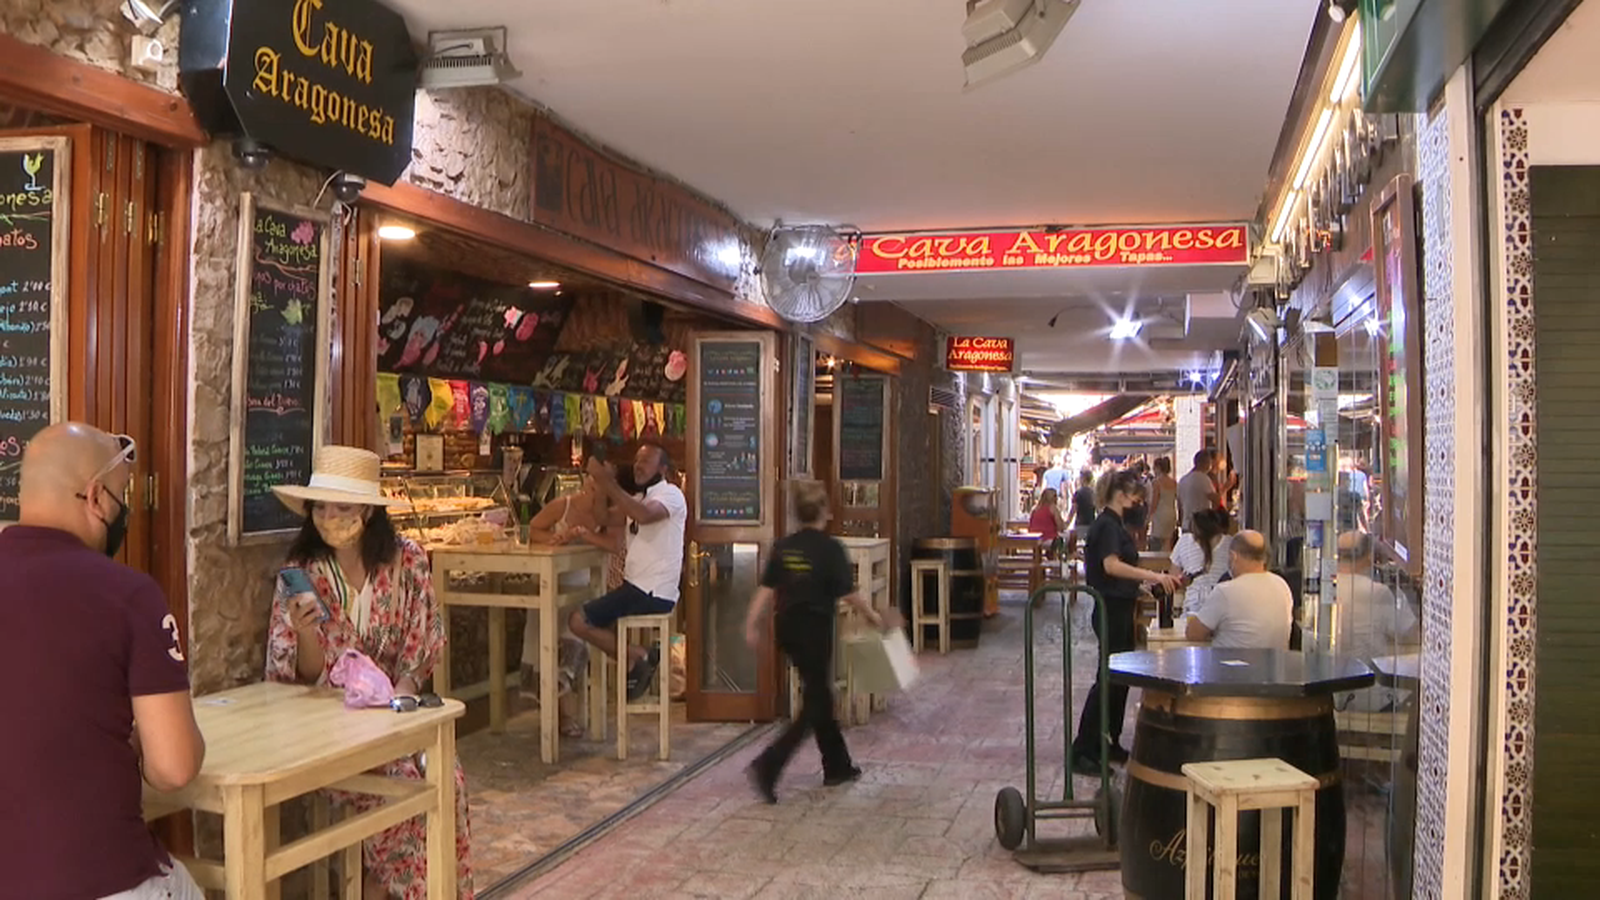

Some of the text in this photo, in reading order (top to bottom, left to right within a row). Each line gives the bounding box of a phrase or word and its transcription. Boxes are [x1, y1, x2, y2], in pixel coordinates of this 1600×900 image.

[291, 0, 374, 84] Cava
[252, 46, 395, 146] Aragonesa
[264, 213, 287, 238] Cava
[872, 235, 993, 260] Cava
[1005, 229, 1244, 261] Aragonesa
[1034, 251, 1092, 267] Mejores
[949, 349, 1013, 364] Aragonesa
[953, 336, 1008, 349] La Cava
[161, 613, 185, 661] 3
